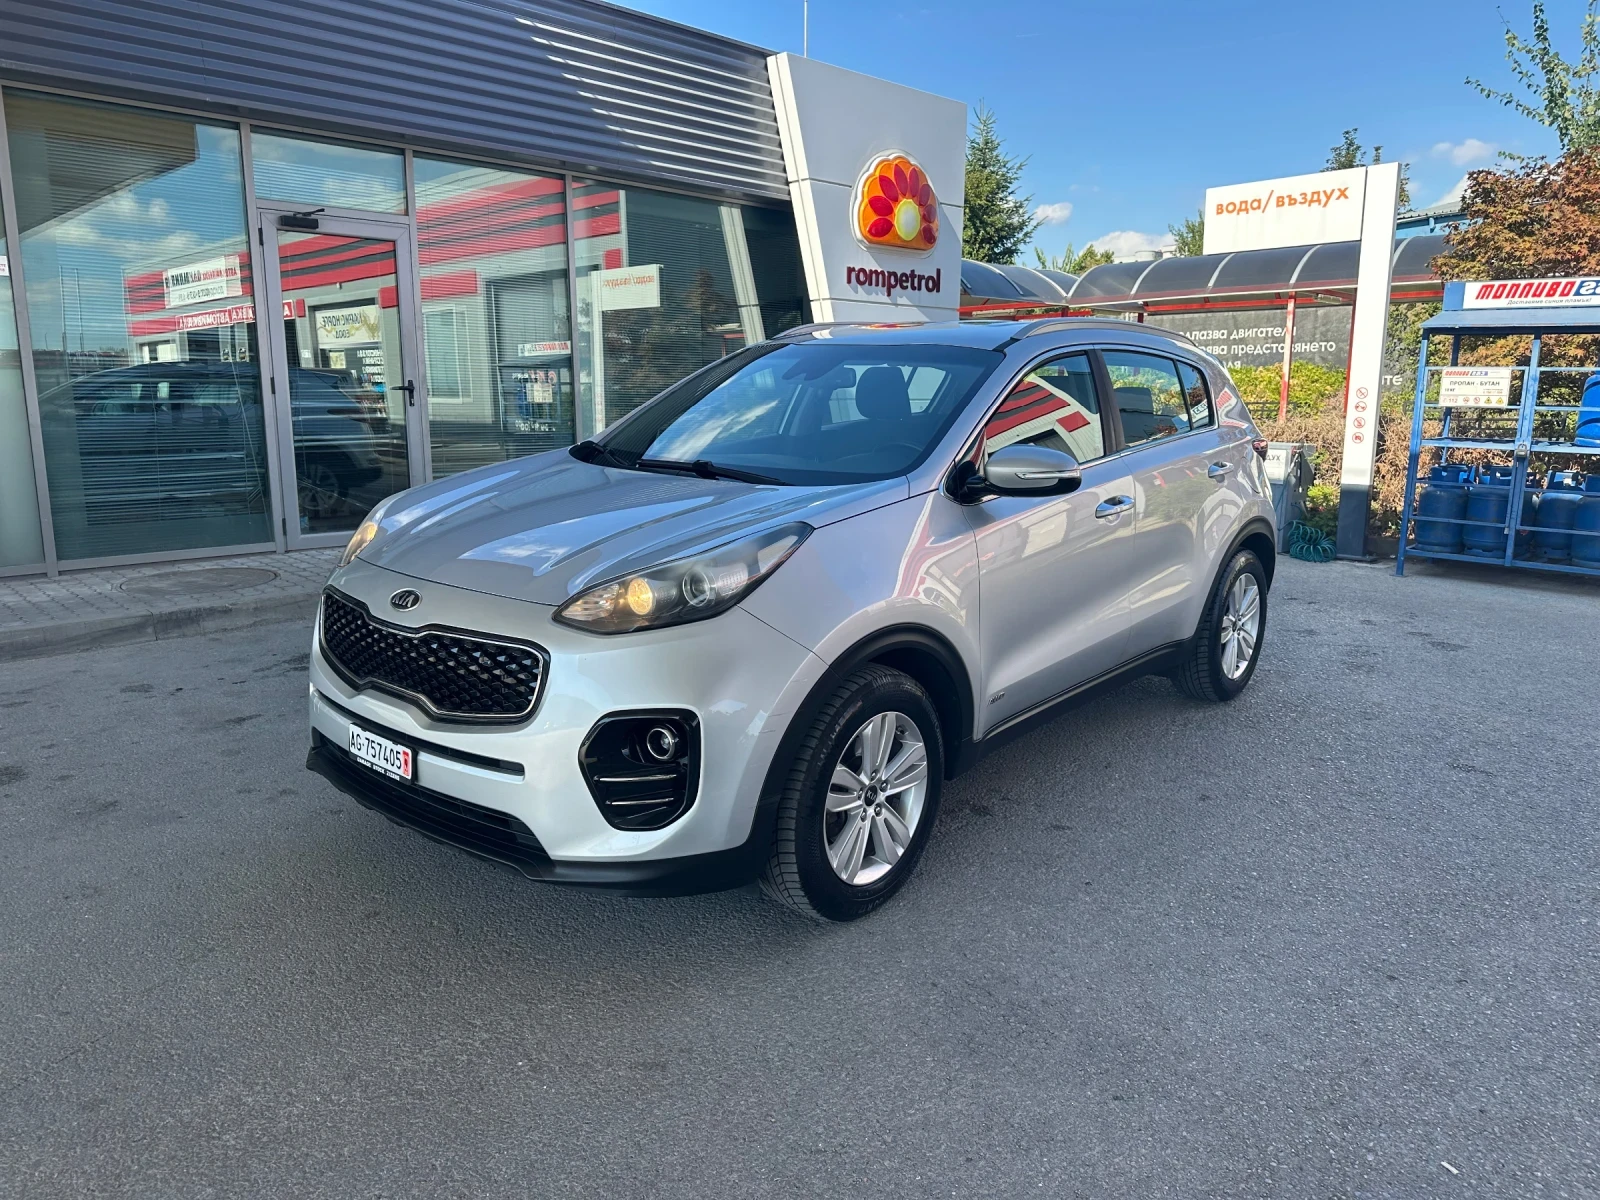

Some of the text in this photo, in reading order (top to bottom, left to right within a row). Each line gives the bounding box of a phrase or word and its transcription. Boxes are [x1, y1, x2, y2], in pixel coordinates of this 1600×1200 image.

[1216, 186, 1349, 215] вода/въздух
[846, 266, 941, 297] rompetrol
[391, 591, 415, 608] KIA
